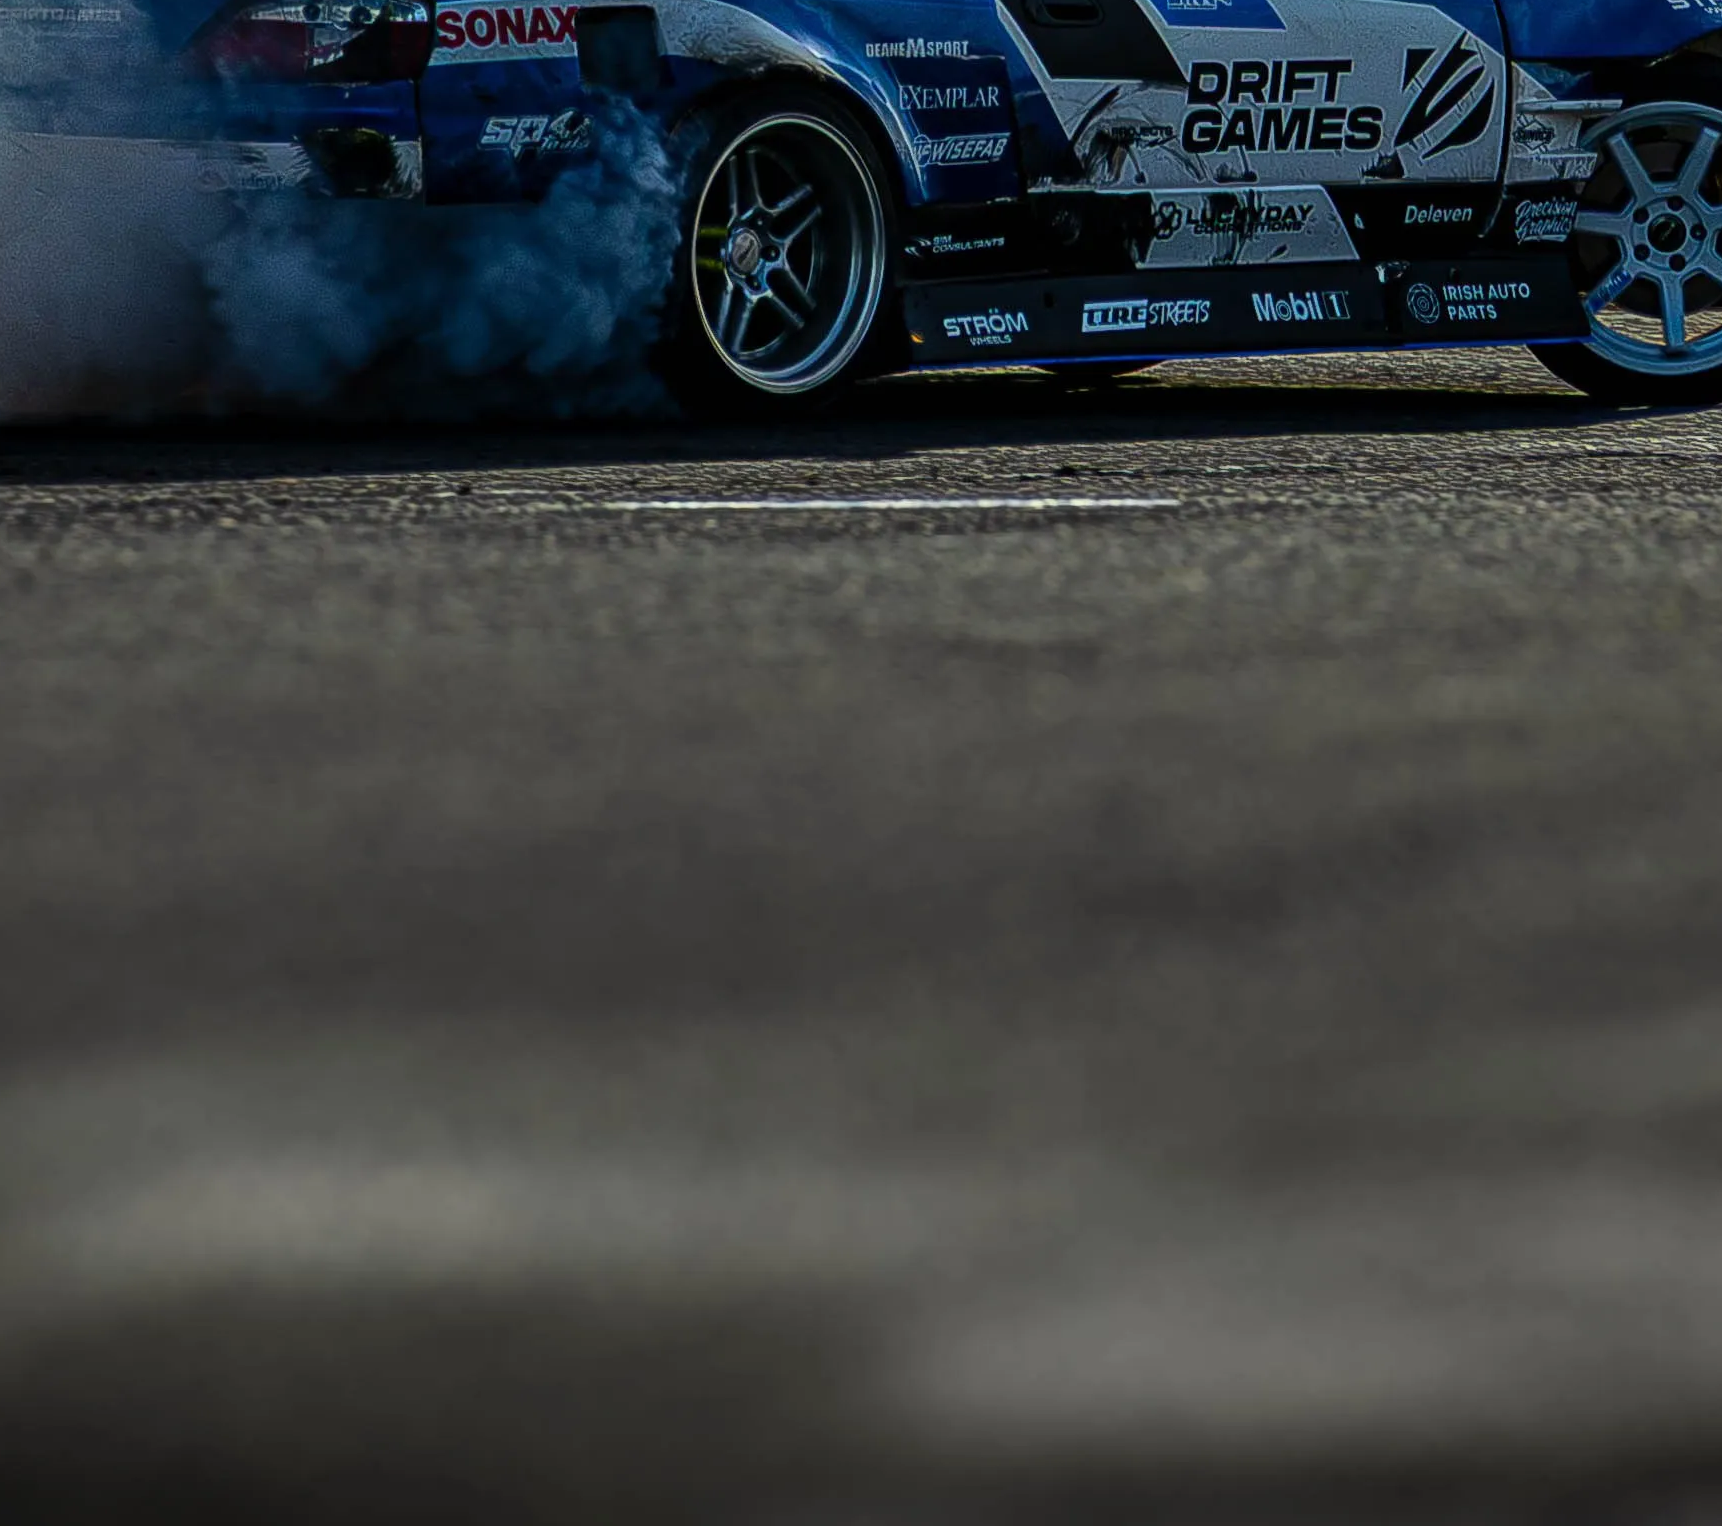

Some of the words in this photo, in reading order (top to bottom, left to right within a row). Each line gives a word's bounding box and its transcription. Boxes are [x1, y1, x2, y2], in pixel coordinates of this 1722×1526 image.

[436, 6, 579, 49] SONAX
[1187, 59, 1353, 104] DRIFT
[899, 85, 1000, 110] EXEMPLAR
[1182, 106, 1383, 154] GAMES
[932, 138, 1008, 161] WISEFAB
[1404, 204, 1473, 224] Deleven
[933, 237, 1005, 253] CONSULTANTS
[1442, 285, 1484, 301] IRISH
[1488, 283, 1530, 299] AUTO
[1251, 292, 1324, 322] Mobil
[1447, 304, 1497, 321] PARTS
[943, 307, 1029, 337] STRÖM
[970, 334, 1012, 347] WHEELS
